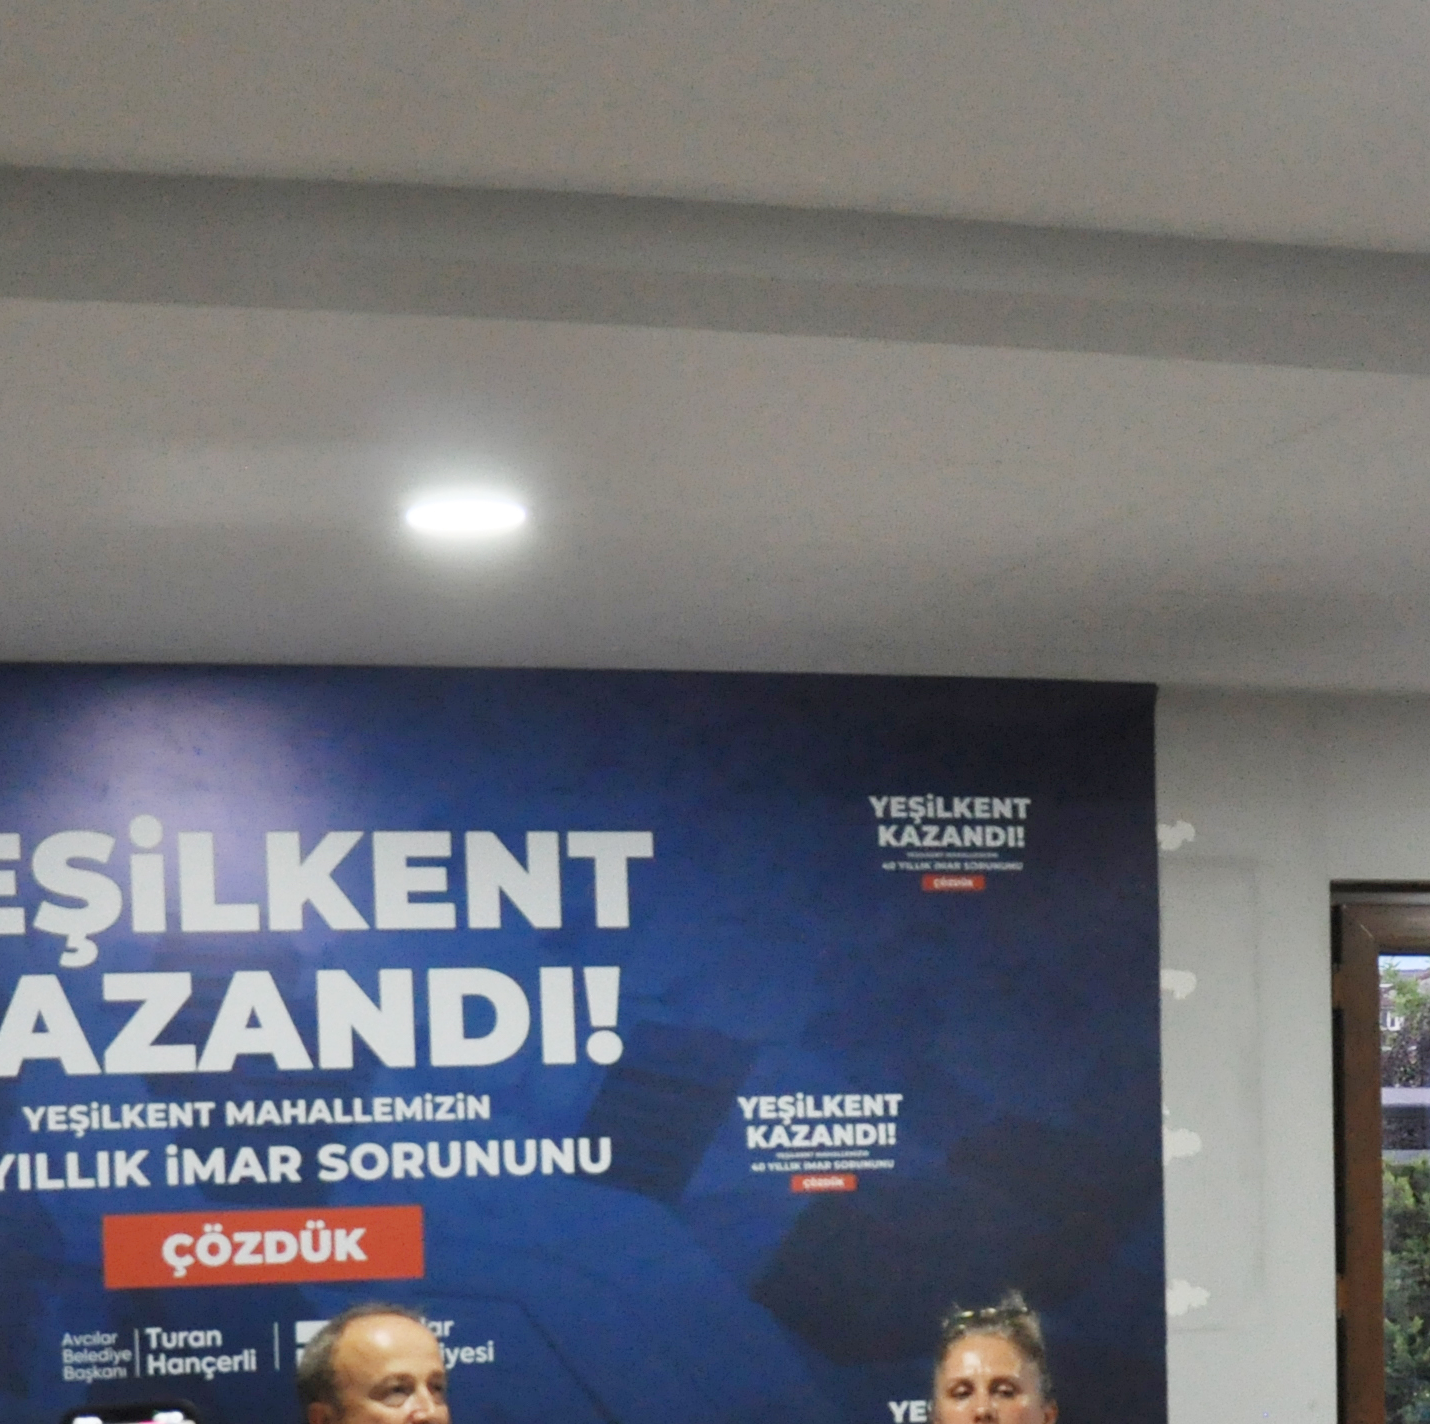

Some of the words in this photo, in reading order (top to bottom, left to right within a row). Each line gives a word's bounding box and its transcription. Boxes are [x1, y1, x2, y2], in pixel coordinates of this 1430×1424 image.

[878, 824, 1026, 847] KAZANDI!
[746, 1123, 897, 1149] KAZANDI!
[318, 1137, 613, 1182] SORUNUNU
[161, 1222, 369, 1281] ÇÖZDÜK
[145, 1327, 222, 1350] Turan
[62, 1348, 132, 1364] Belediye
[146, 1349, 257, 1380] Hançerli
